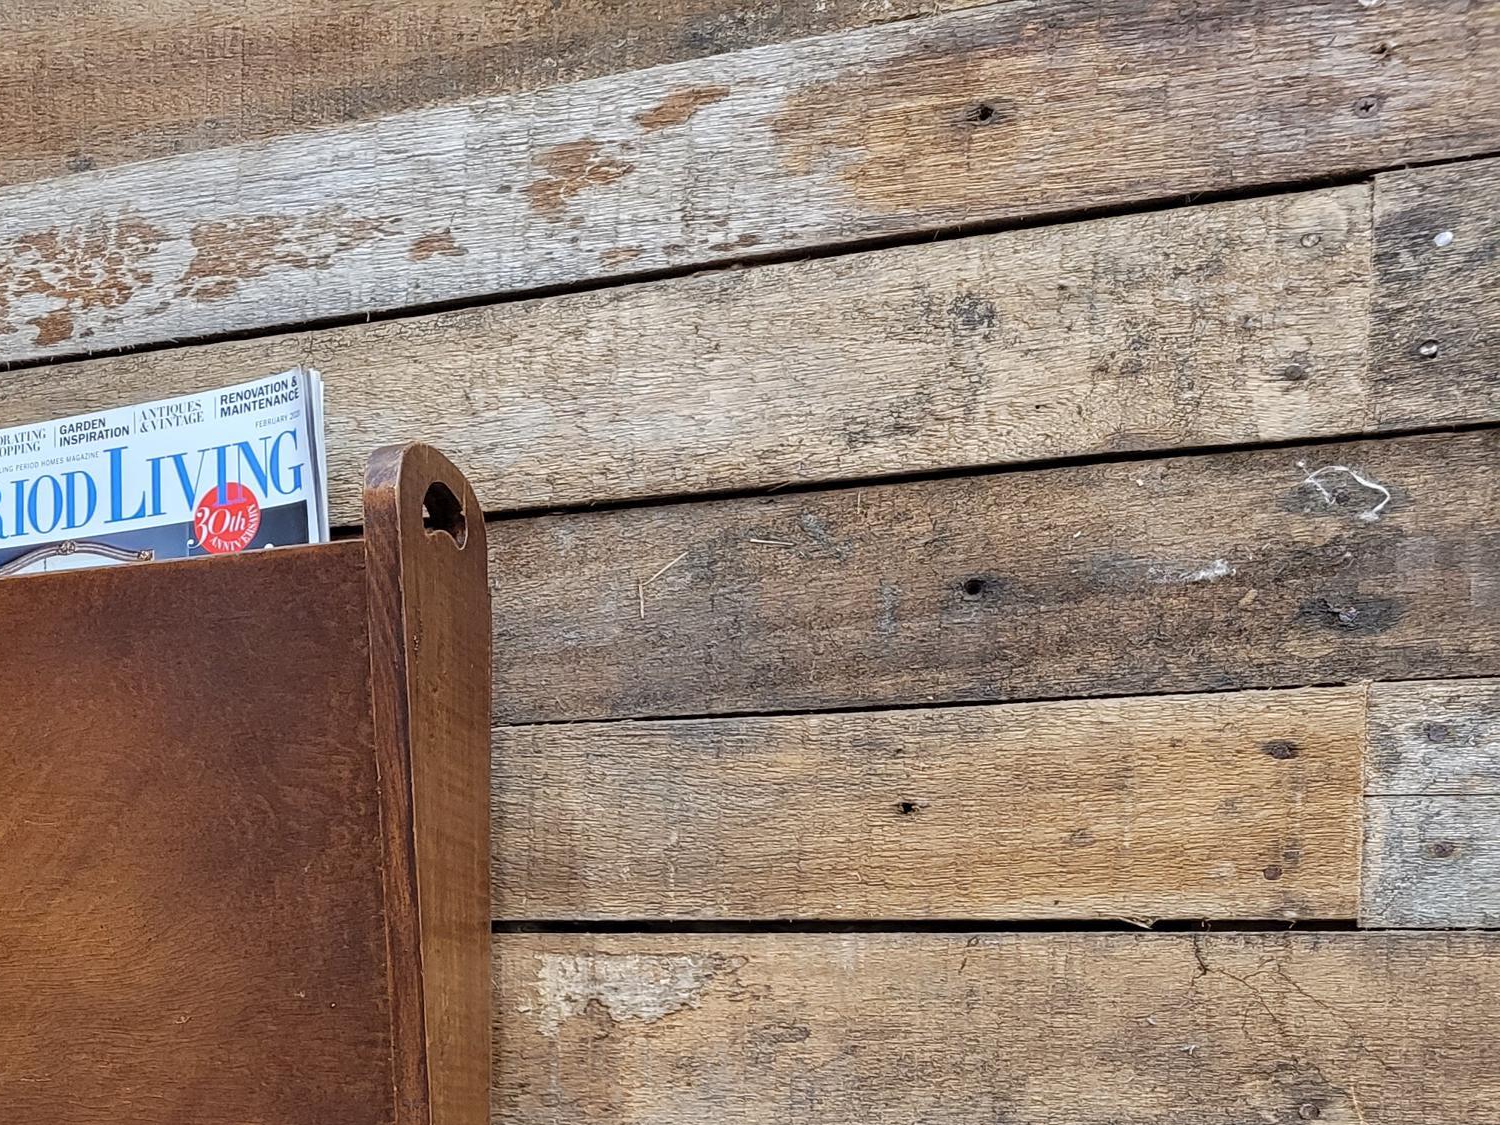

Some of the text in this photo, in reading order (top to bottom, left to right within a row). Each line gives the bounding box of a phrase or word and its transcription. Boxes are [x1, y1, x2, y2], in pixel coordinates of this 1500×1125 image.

[220, 376, 298, 405] RENOVATION &
[140, 400, 202, 420] ANTIQUES
[220, 388, 300, 418] MAINTENANCE
[59, 417, 106, 435] GARDEN
[255, 415, 288, 428] FEBRUARY
[59, 426, 130, 447] INSPIRATION
[15, 461, 40, 472] PERIOD
[41, 457, 65, 468] HOMES
[66, 451, 100, 464] MAGAZINE
[187, 506, 247, 548] 30th
